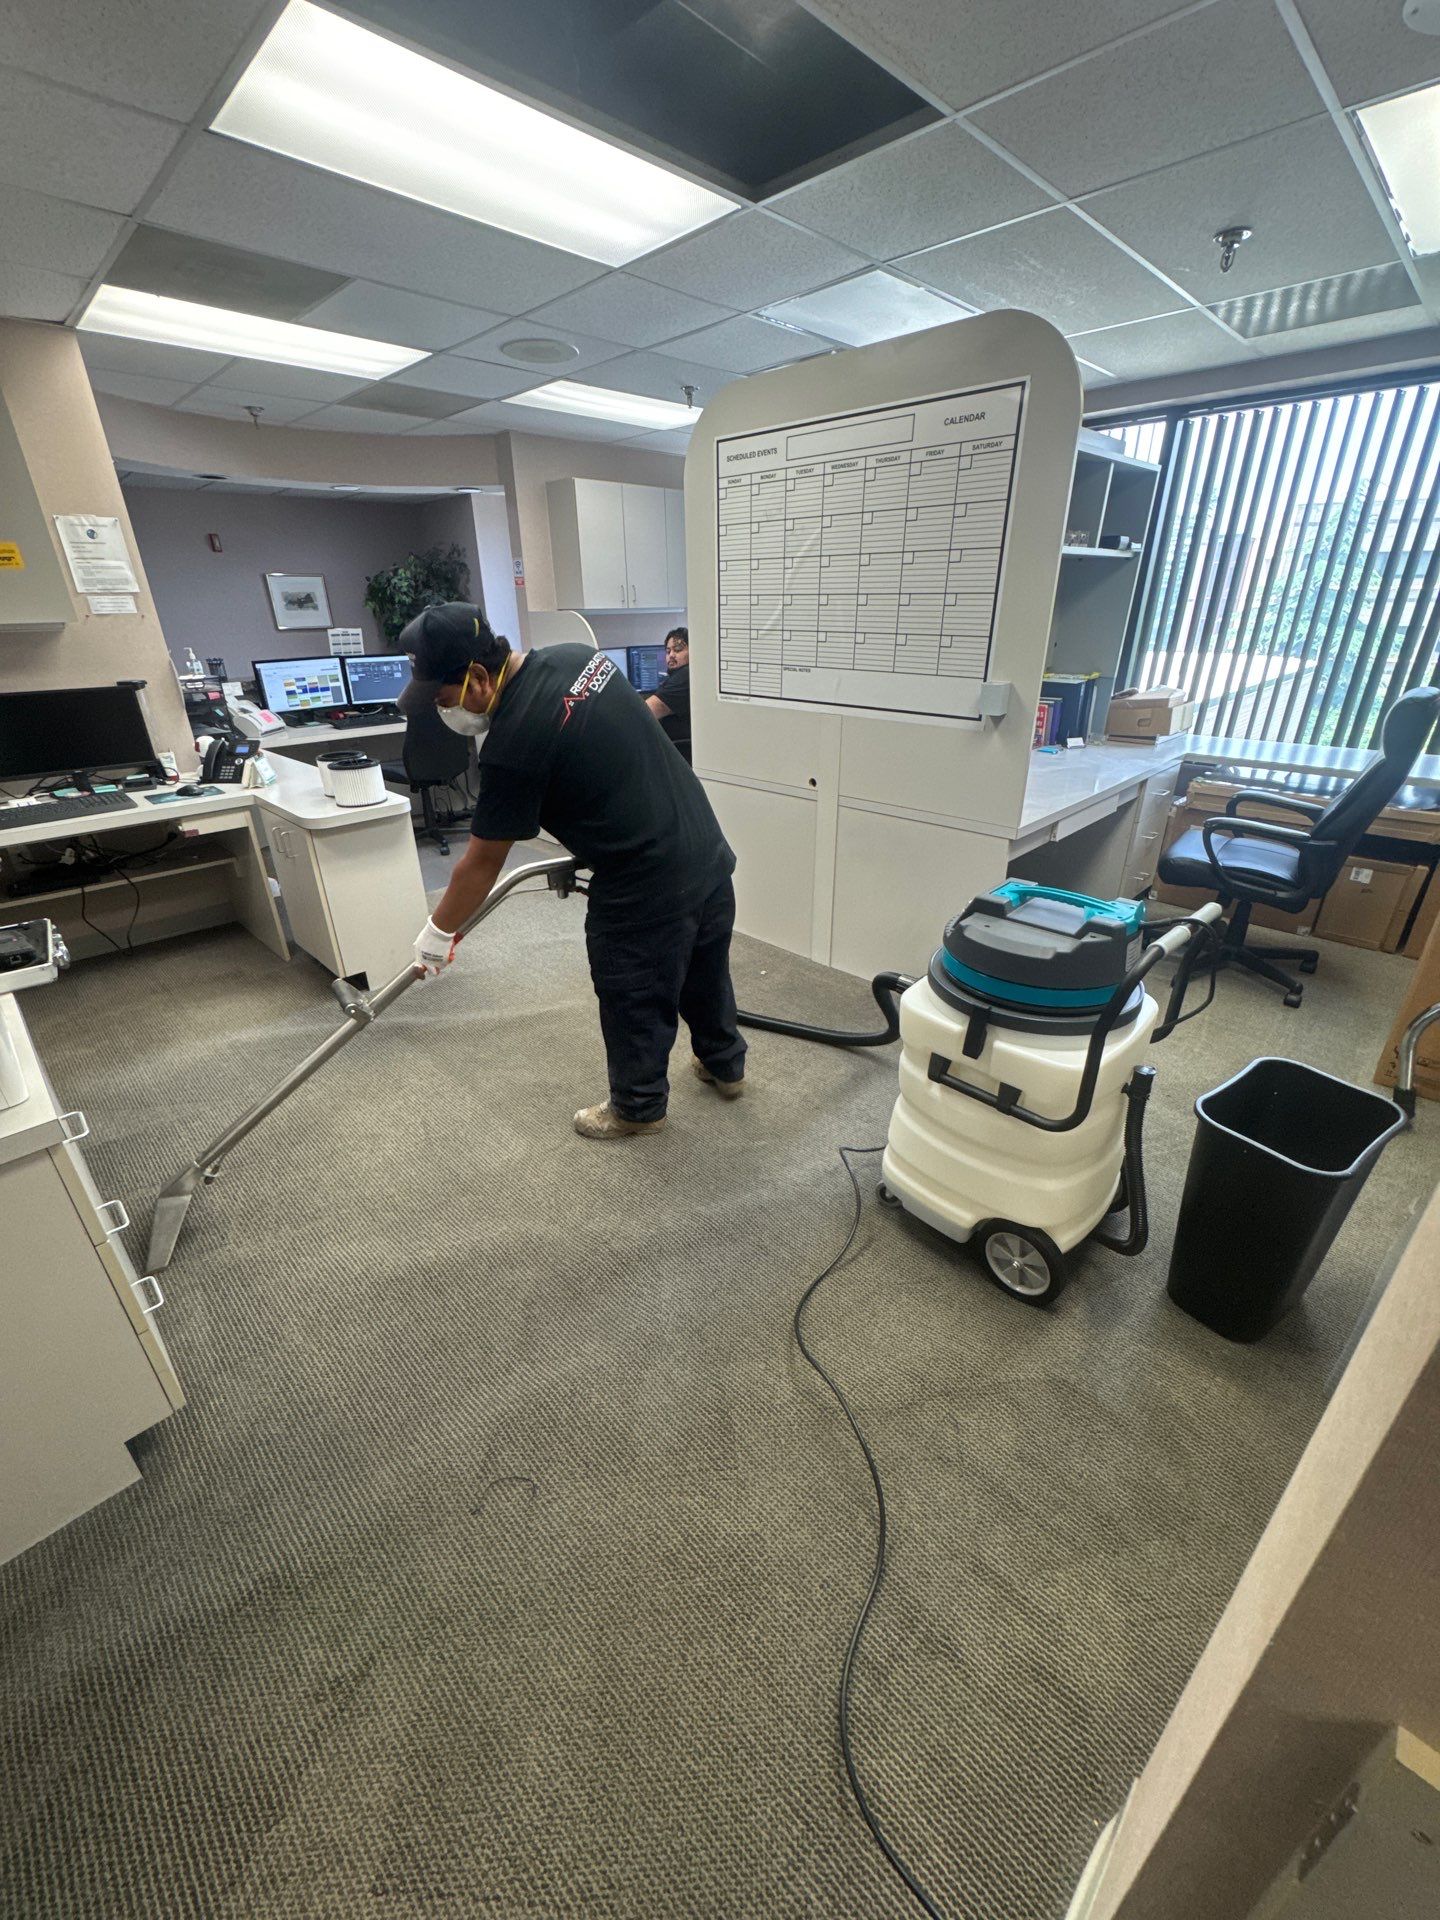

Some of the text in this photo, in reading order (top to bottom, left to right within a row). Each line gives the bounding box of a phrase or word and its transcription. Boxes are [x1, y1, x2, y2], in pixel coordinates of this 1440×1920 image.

[943, 411, 986, 426] CALENDAR
[972, 440, 1003, 451] SATURDAY
[726, 447, 778, 463] SCHEDULED EVENTS
[925, 448, 945, 457] FRIDAY
[875, 455, 901, 464] THURSDAY
[795, 467, 815, 475] TUESDAY
[831, 461, 860, 471] WEDNESDAY
[569, 651, 606, 696] RESTORATIO
